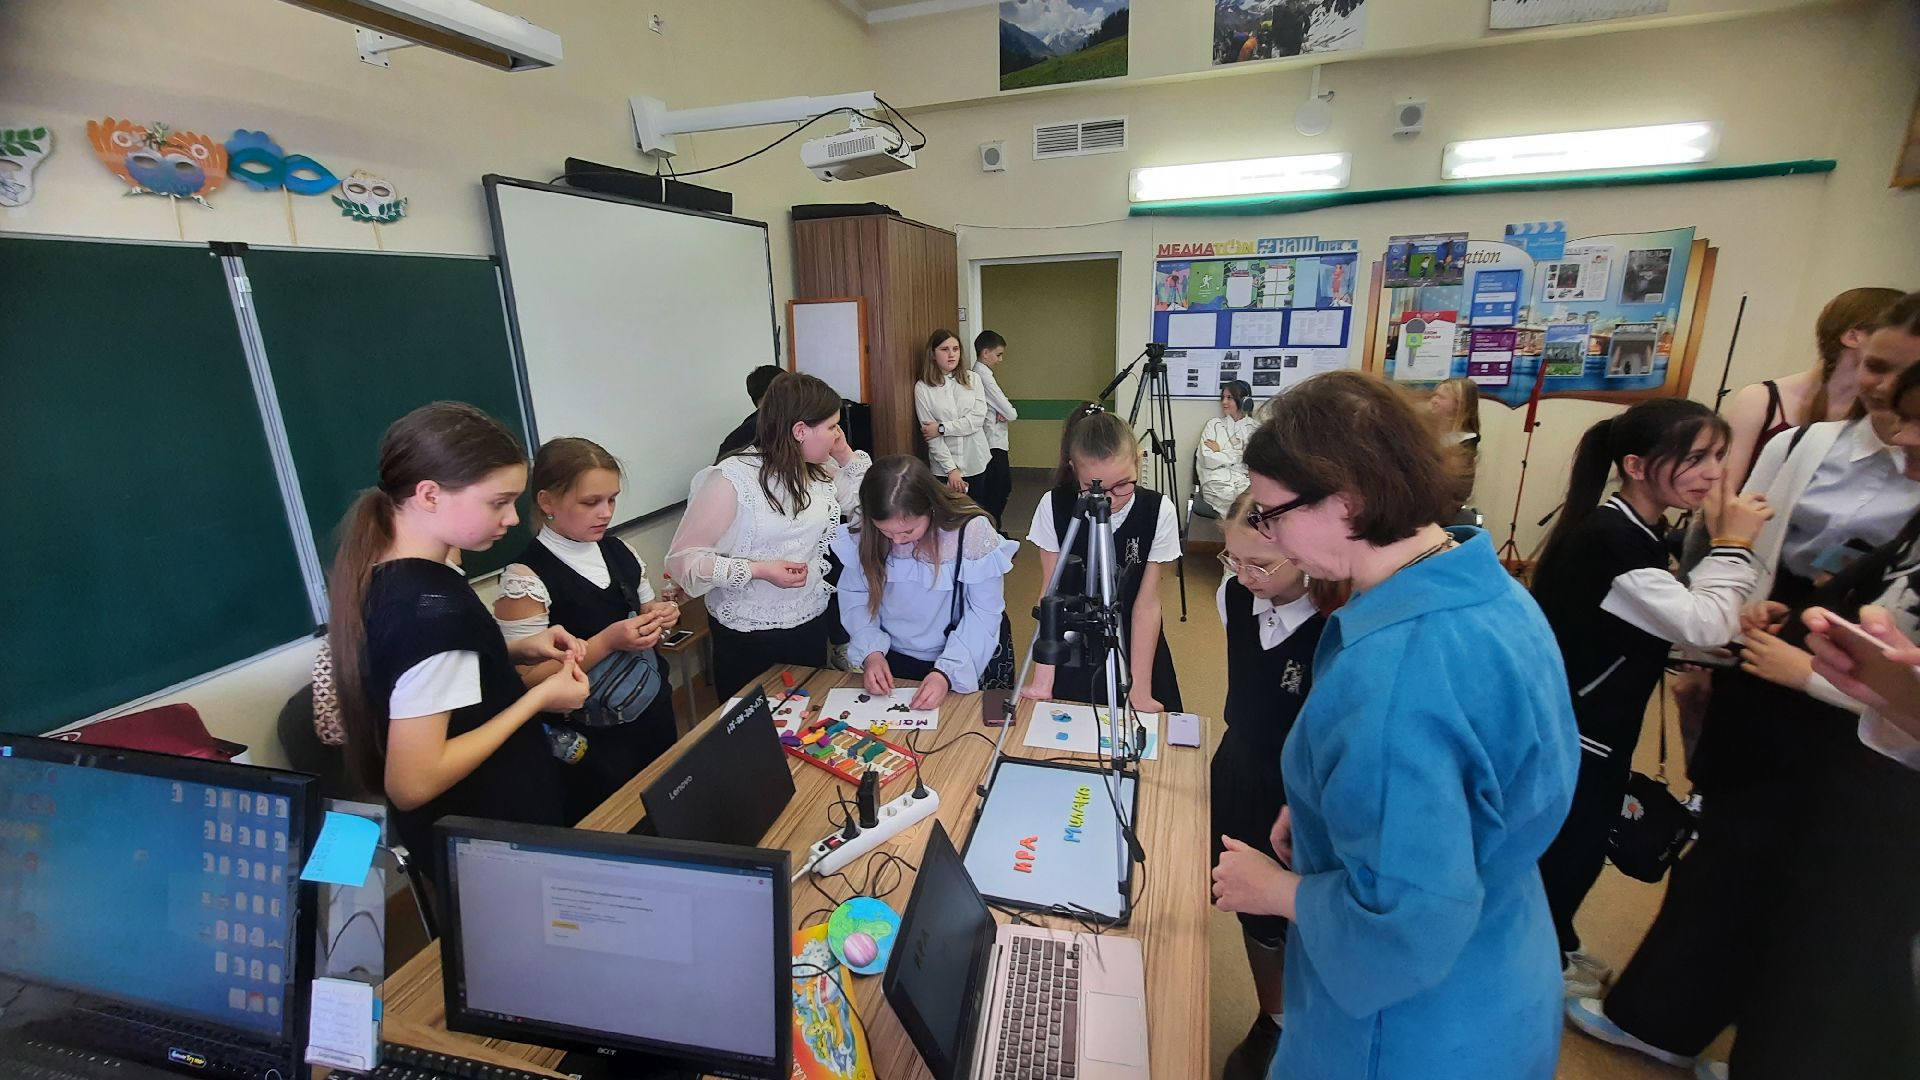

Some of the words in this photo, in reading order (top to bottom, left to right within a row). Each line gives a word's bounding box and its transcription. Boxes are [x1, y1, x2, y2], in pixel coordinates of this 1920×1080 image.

[1464, 250, 1501, 264] ation
[668, 775, 693, 801] Lenovo
[1013, 835, 1039, 873] ИРА
